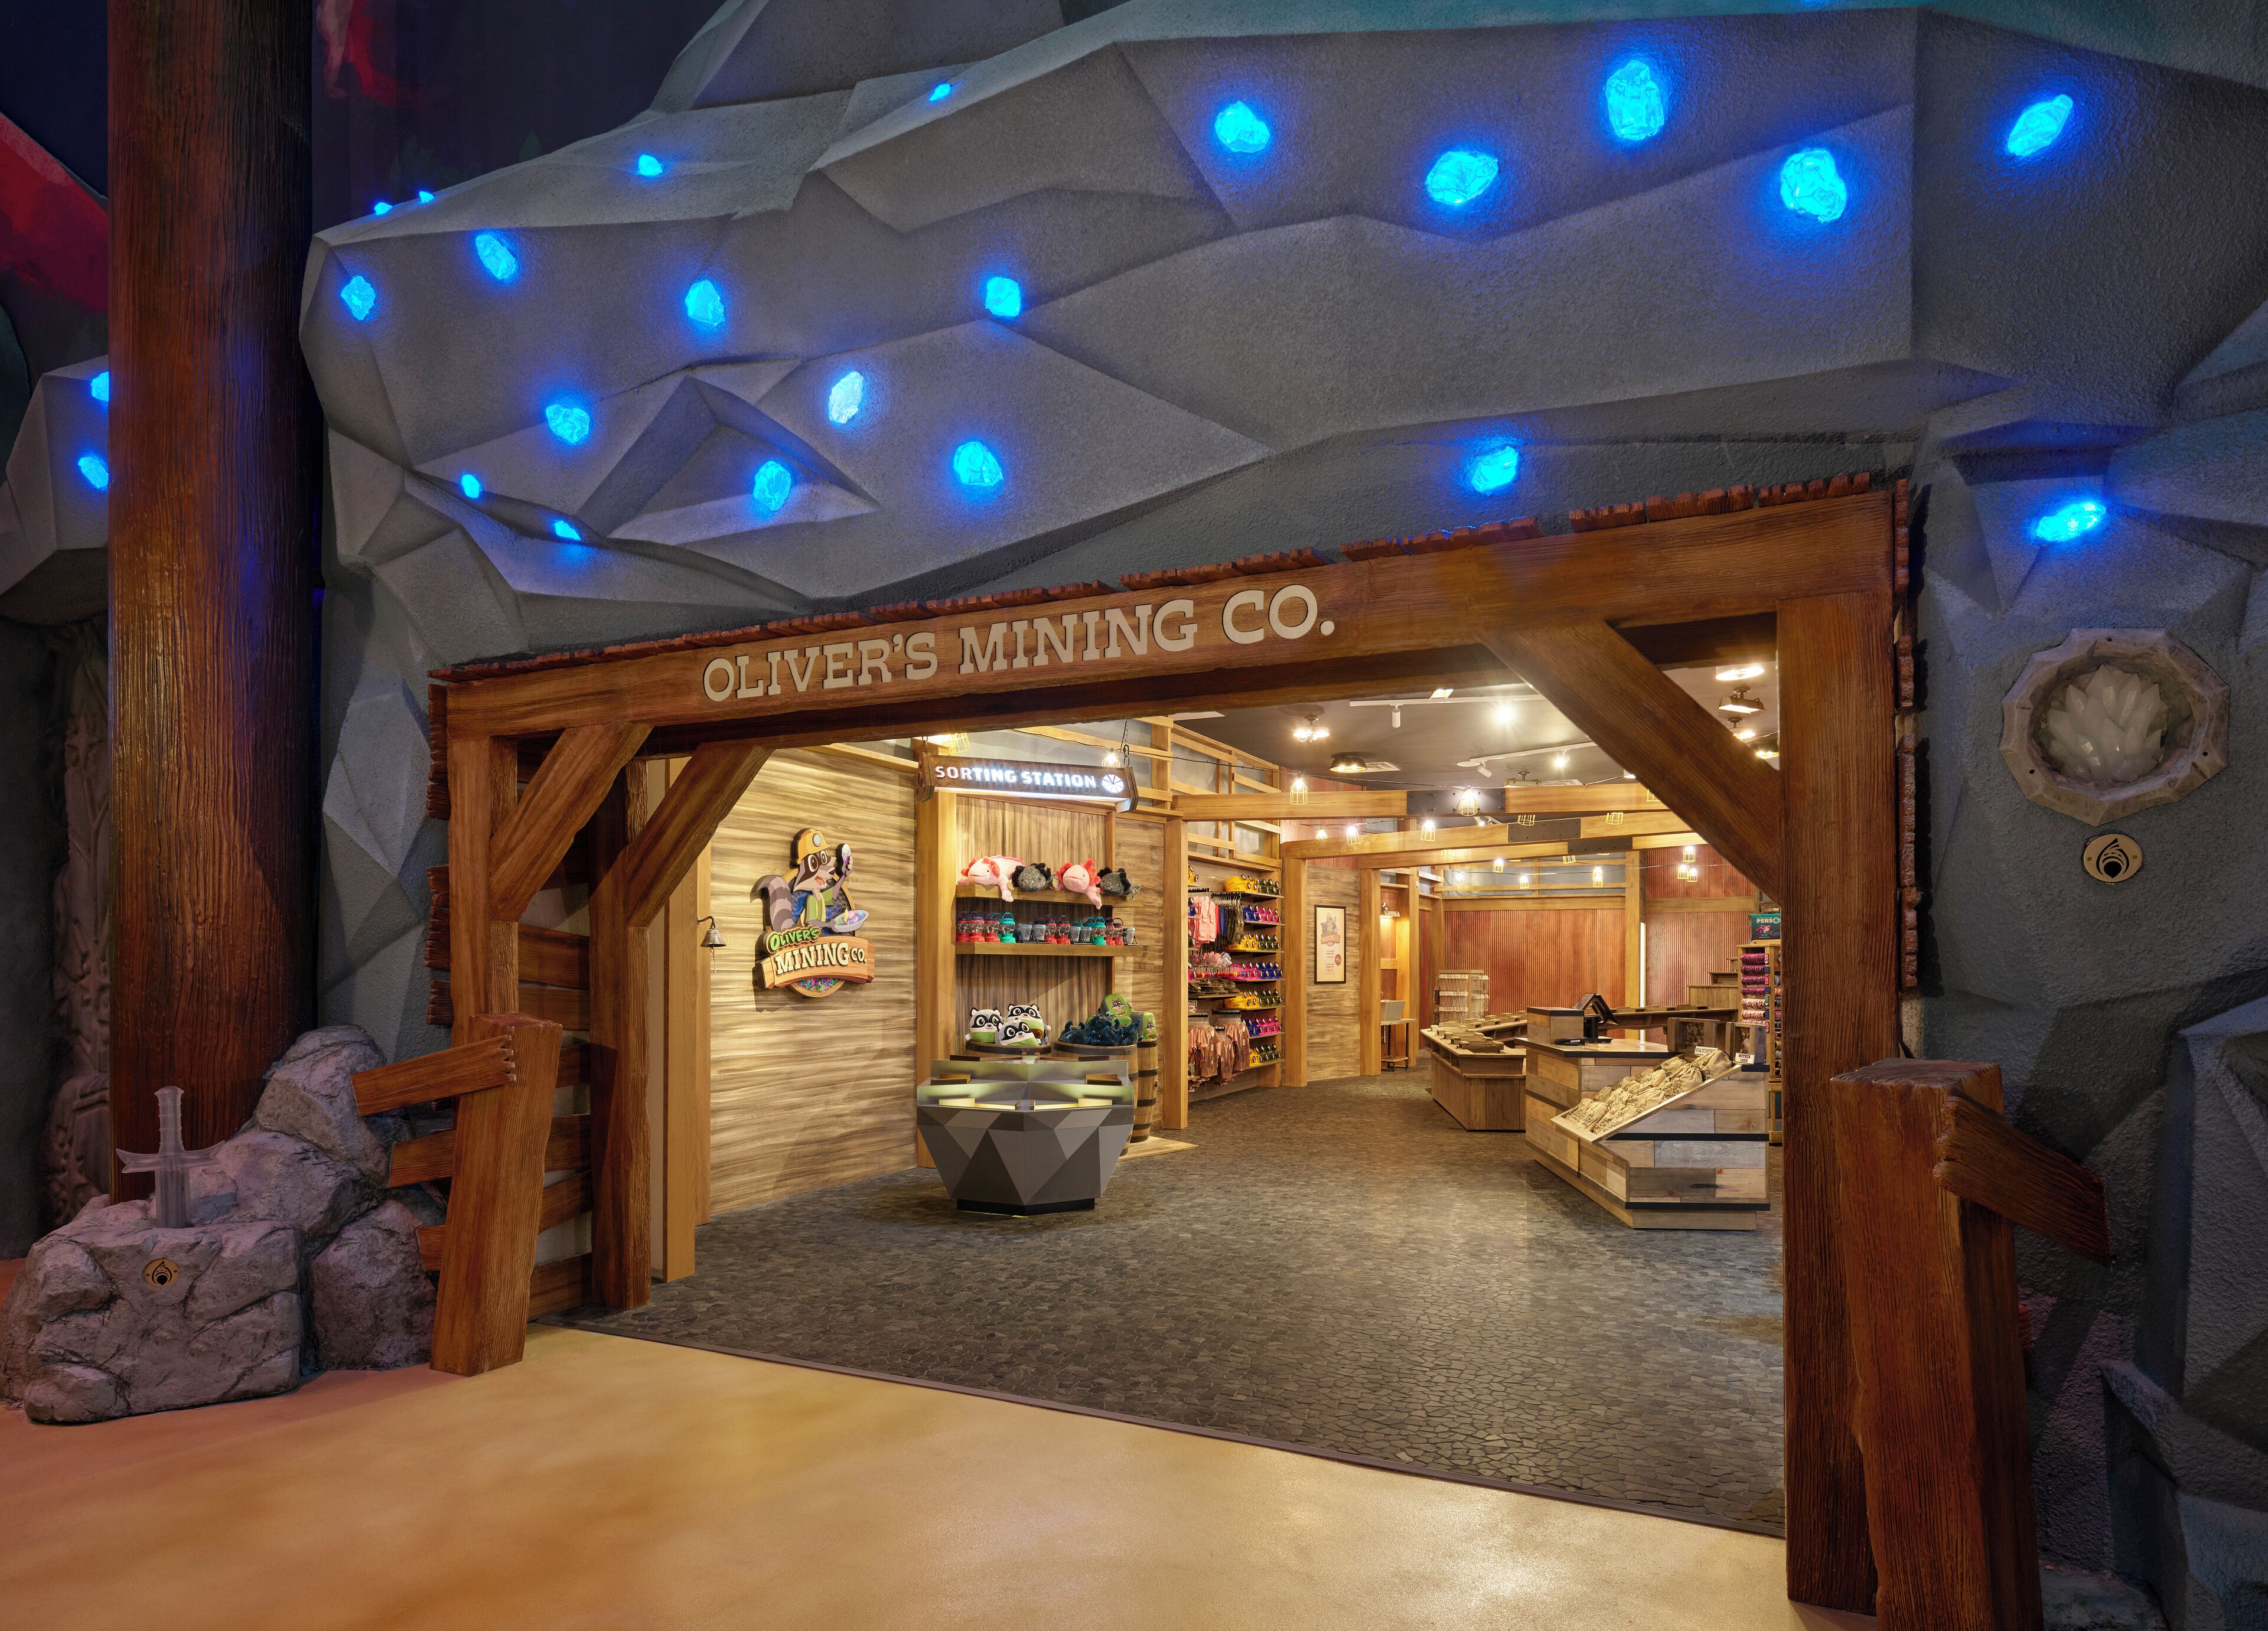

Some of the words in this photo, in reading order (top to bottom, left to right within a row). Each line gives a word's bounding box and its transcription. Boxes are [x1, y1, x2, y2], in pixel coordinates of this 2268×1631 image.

[703, 631, 939, 702] OLIVER'S
[959, 599, 1198, 674] MINING
[1222, 584, 1335, 644] CO.
[935, 766, 1017, 785] SORTING
[1021, 771, 1097, 788] STATION
[770, 927, 821, 951] OLIVER'S
[774, 942, 849, 975] MINING
[850, 947, 867, 963] CO.
